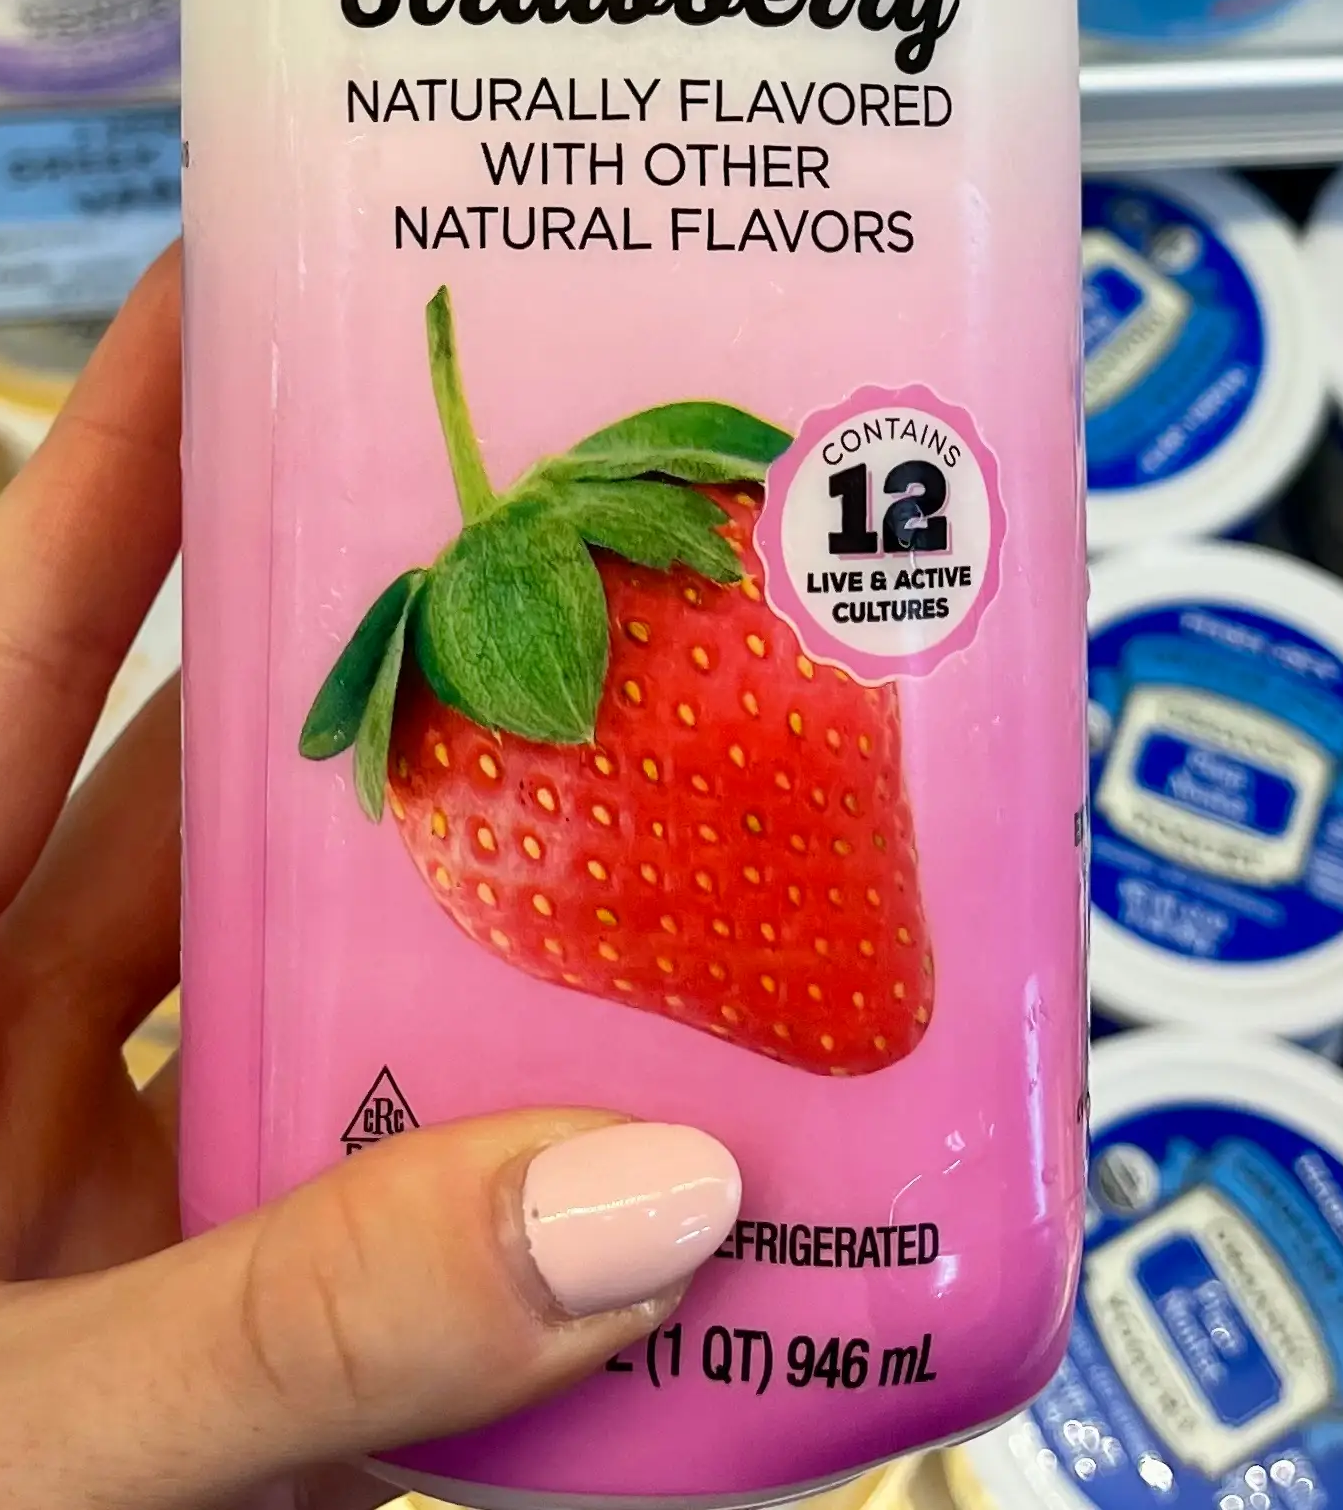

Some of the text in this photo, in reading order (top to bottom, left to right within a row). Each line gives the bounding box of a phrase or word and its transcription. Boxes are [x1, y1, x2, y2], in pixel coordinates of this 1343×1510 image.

[347, 76, 952, 127] NATURALLY FLAVORED
[480, 141, 831, 189] WITH OTHER
[395, 205, 914, 254] NATURAL FLAVORS
[822, 417, 961, 468] CONTAINS
[828, 459, 949, 556] 12
[806, 565, 972, 594] LIVE & ACTIVE
[831, 597, 950, 624] CULTURES
[714, 1219, 940, 1268] EFRIGERATED
[646, 1323, 938, 1396] (1 QT) 946 mL
